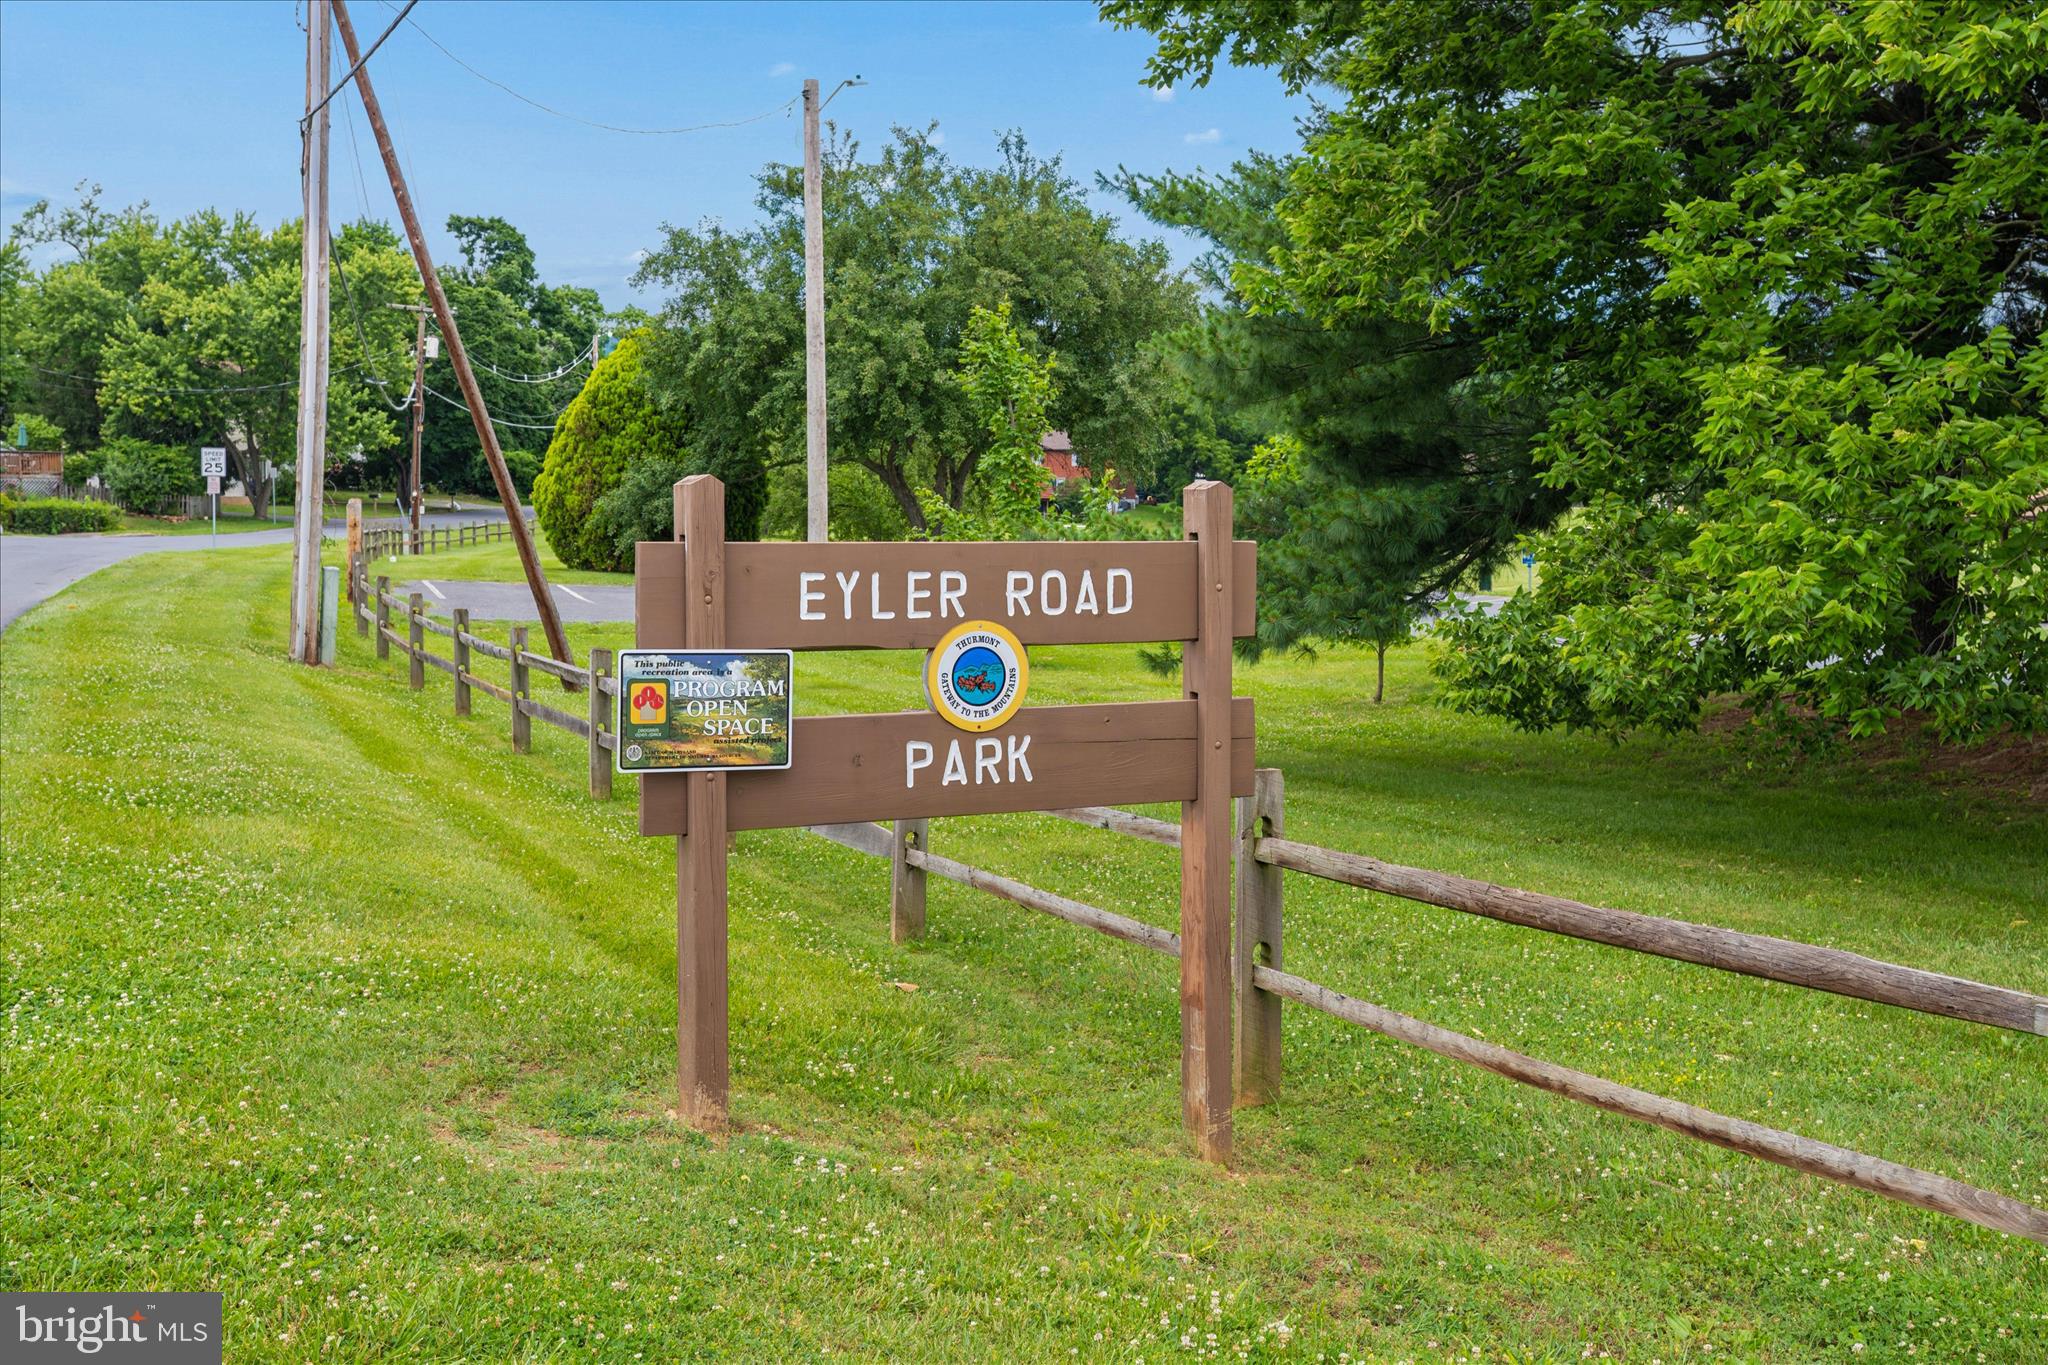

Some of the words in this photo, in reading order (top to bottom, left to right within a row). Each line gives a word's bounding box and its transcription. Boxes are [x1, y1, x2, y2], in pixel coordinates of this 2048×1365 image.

[204, 462, 223, 473] 25
[799, 570, 967, 621] EYLER
[1006, 567, 1134, 617] ROAD
[956, 635, 1000, 650] THURMONT
[634, 660, 653, 668] This
[656, 660, 684, 669] public
[642, 668, 689, 676] recreation
[716, 668, 724, 676] is
[673, 679, 784, 698] PROGRAM
[941, 672, 961, 710] GATEWAY
[961, 707, 971, 717] TO
[973, 708, 990, 718] THE
[992, 667, 1016, 713] MOUNTAINS
[687, 700, 747, 717] OPEN
[703, 718, 774, 736] SPACE
[713, 736, 750, 744] assisted
[751, 736, 782, 745] project
[905, 734, 1034, 789] PARK
